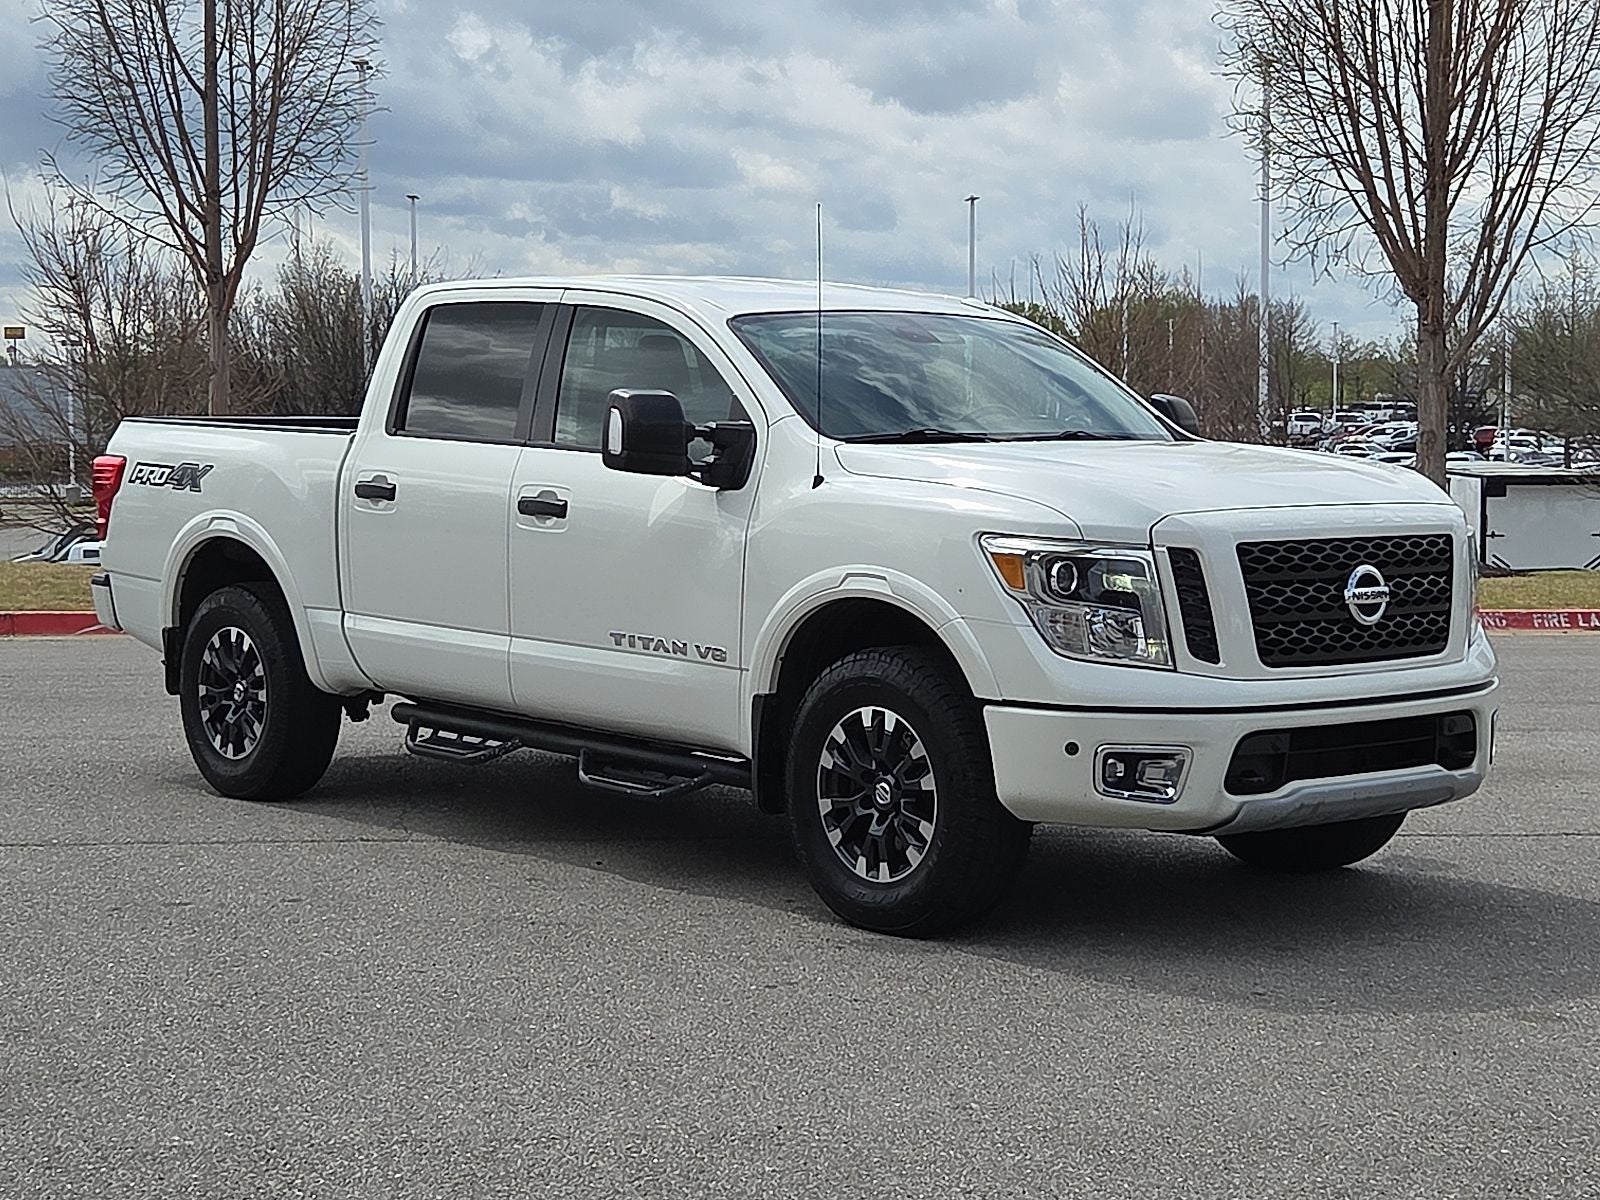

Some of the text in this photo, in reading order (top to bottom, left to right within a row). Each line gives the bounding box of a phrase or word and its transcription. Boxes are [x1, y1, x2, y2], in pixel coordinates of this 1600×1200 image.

[1351, 590, 1389, 601] NISSAN
[1532, 612, 1571, 628] FIRE
[609, 631, 727, 662] TITAN V8
